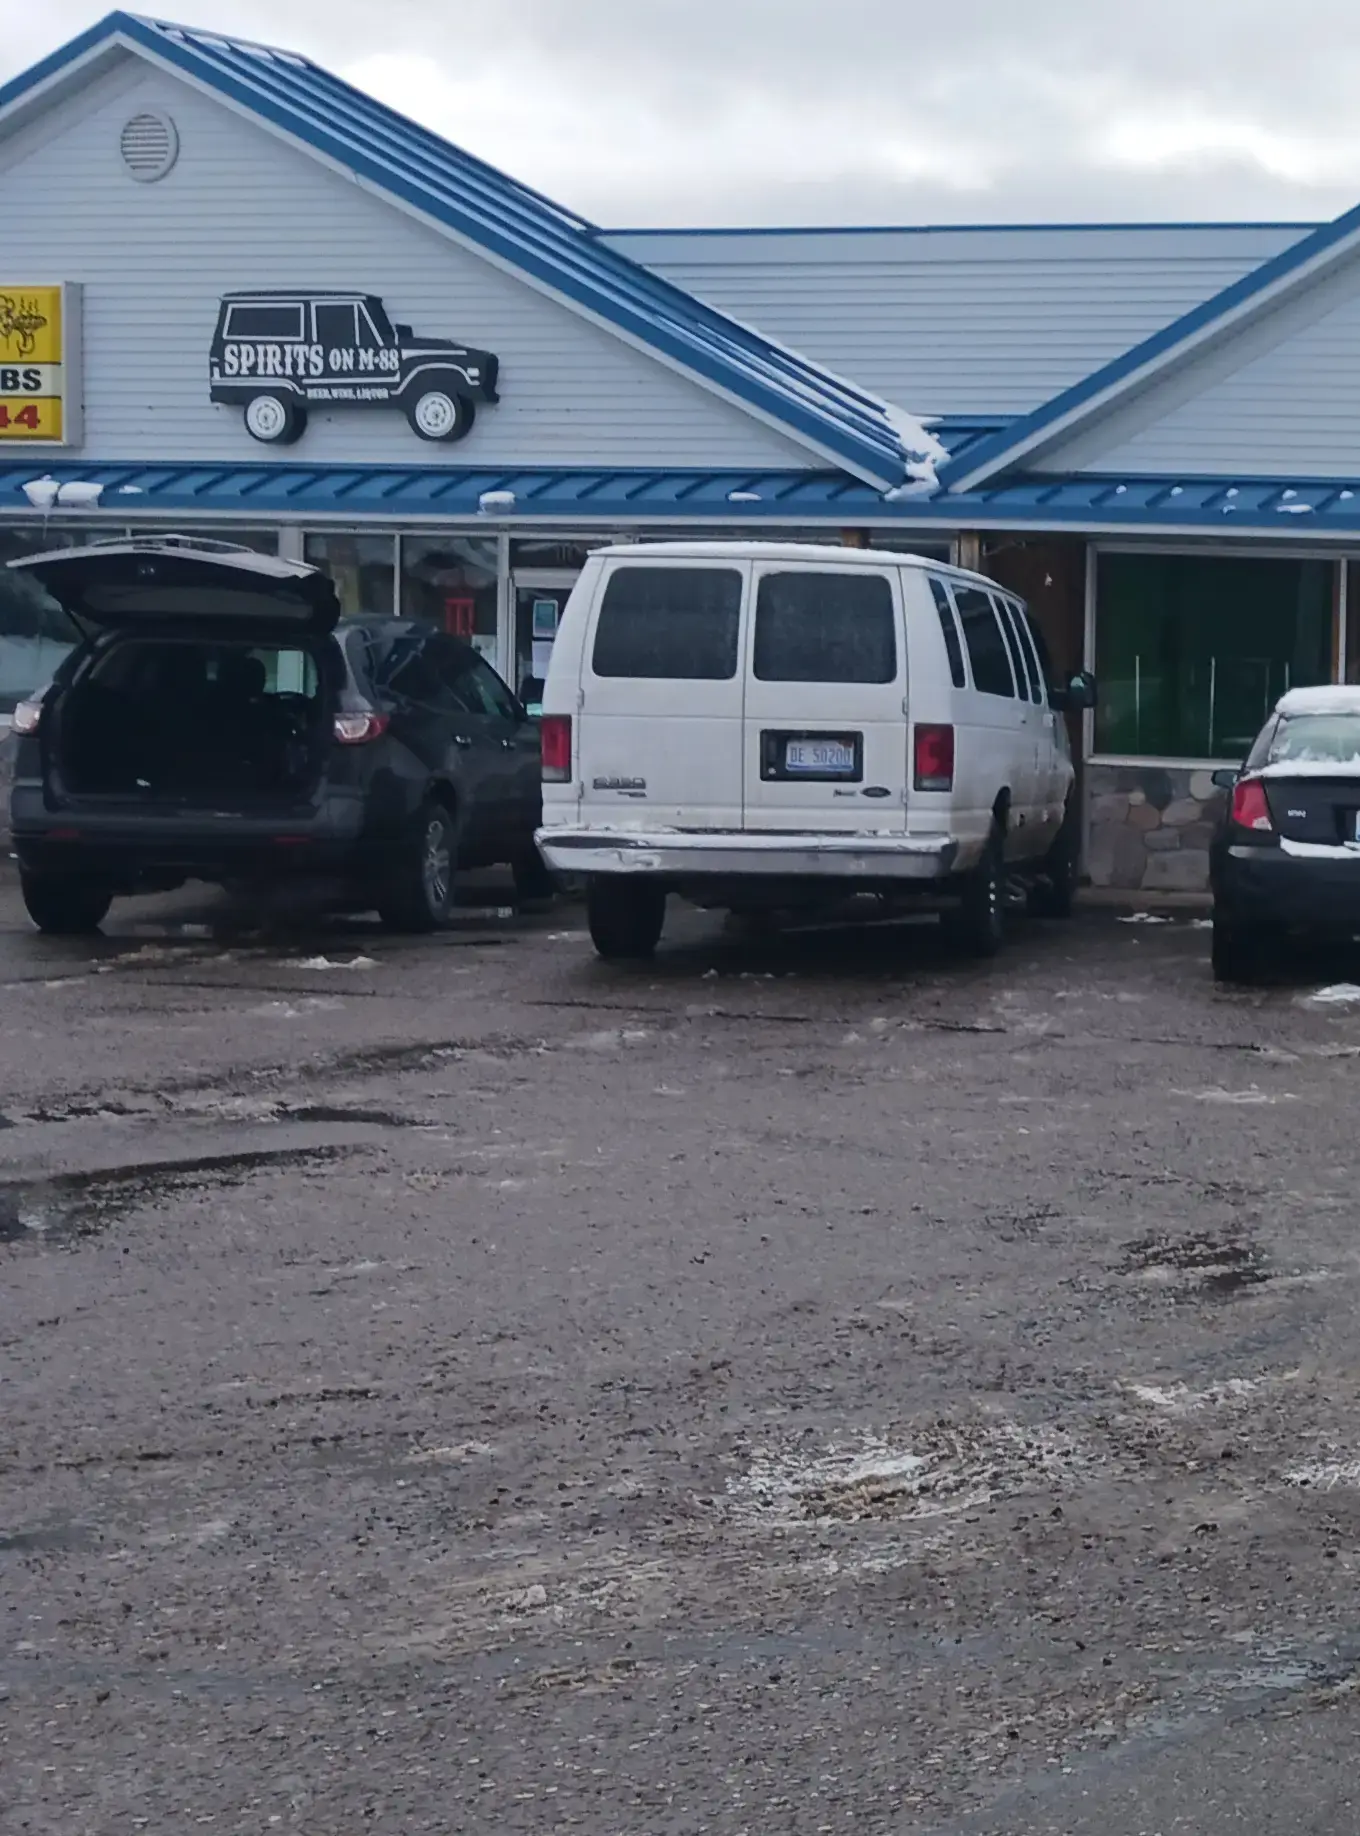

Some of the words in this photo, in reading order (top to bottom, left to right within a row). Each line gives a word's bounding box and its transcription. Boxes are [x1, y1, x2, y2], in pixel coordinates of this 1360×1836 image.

[224, 344, 324, 376] SPIRITS
[329, 348, 354, 371] ON
[358, 348, 399, 371] M-88
